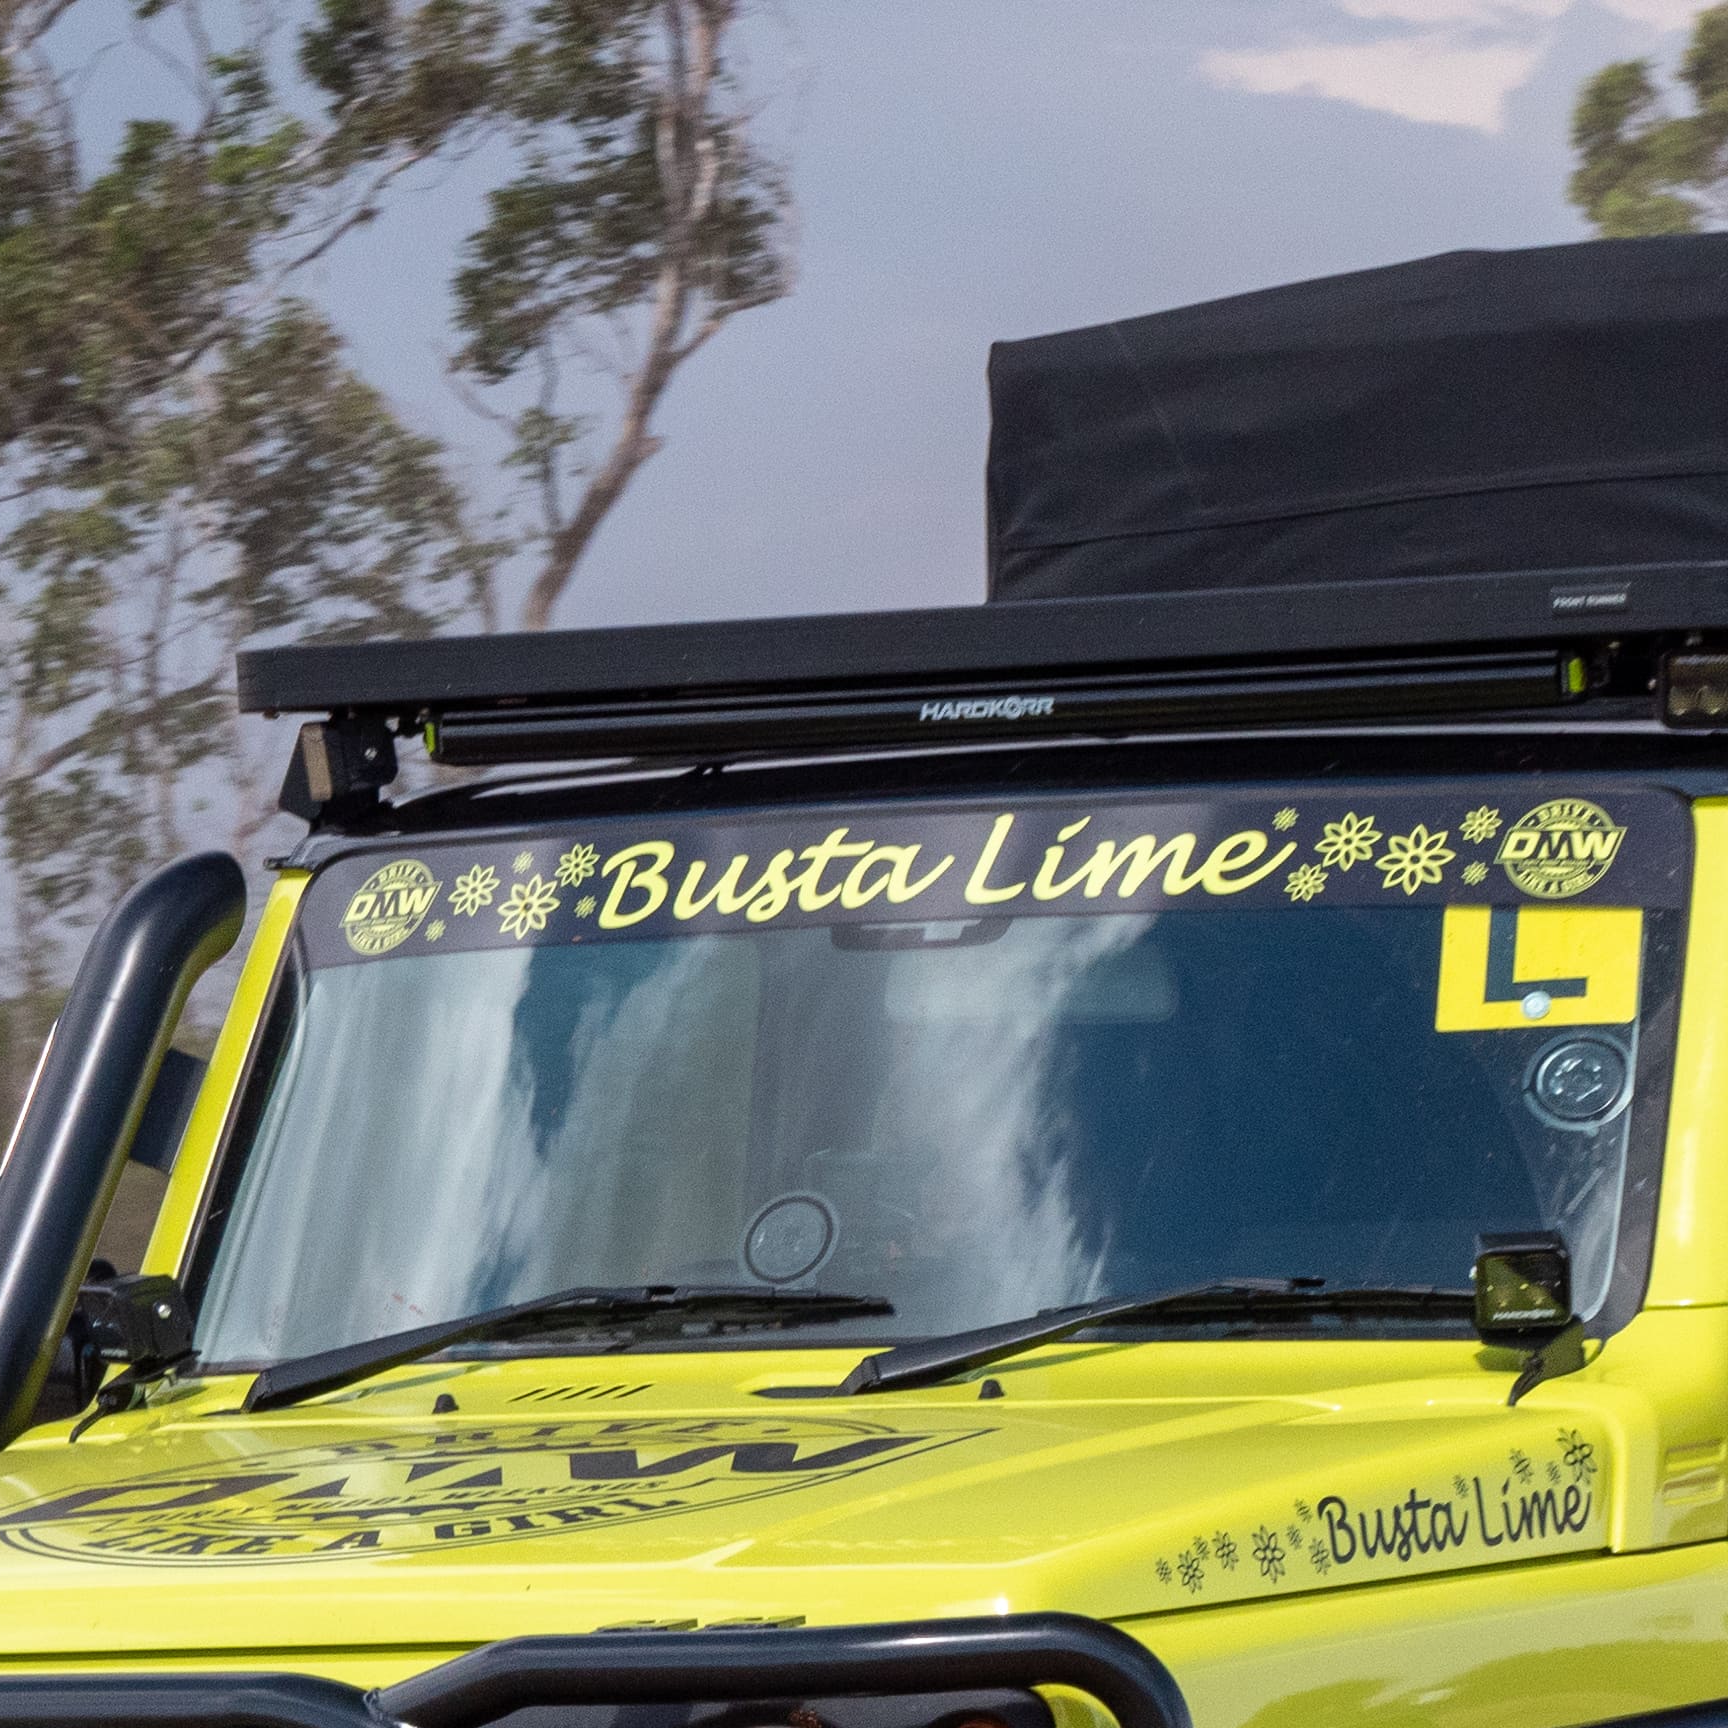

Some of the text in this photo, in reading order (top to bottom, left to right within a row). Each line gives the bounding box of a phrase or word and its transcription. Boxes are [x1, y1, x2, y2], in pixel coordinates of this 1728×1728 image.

[598, 813, 1297, 929] Busta Lime
[1500, 830, 1621, 859] DMW
[344, 885, 438, 923] DMW
[80, 1498, 694, 1555] LIKE A GIRL
[1317, 1476, 1592, 1565] Busta Lime
